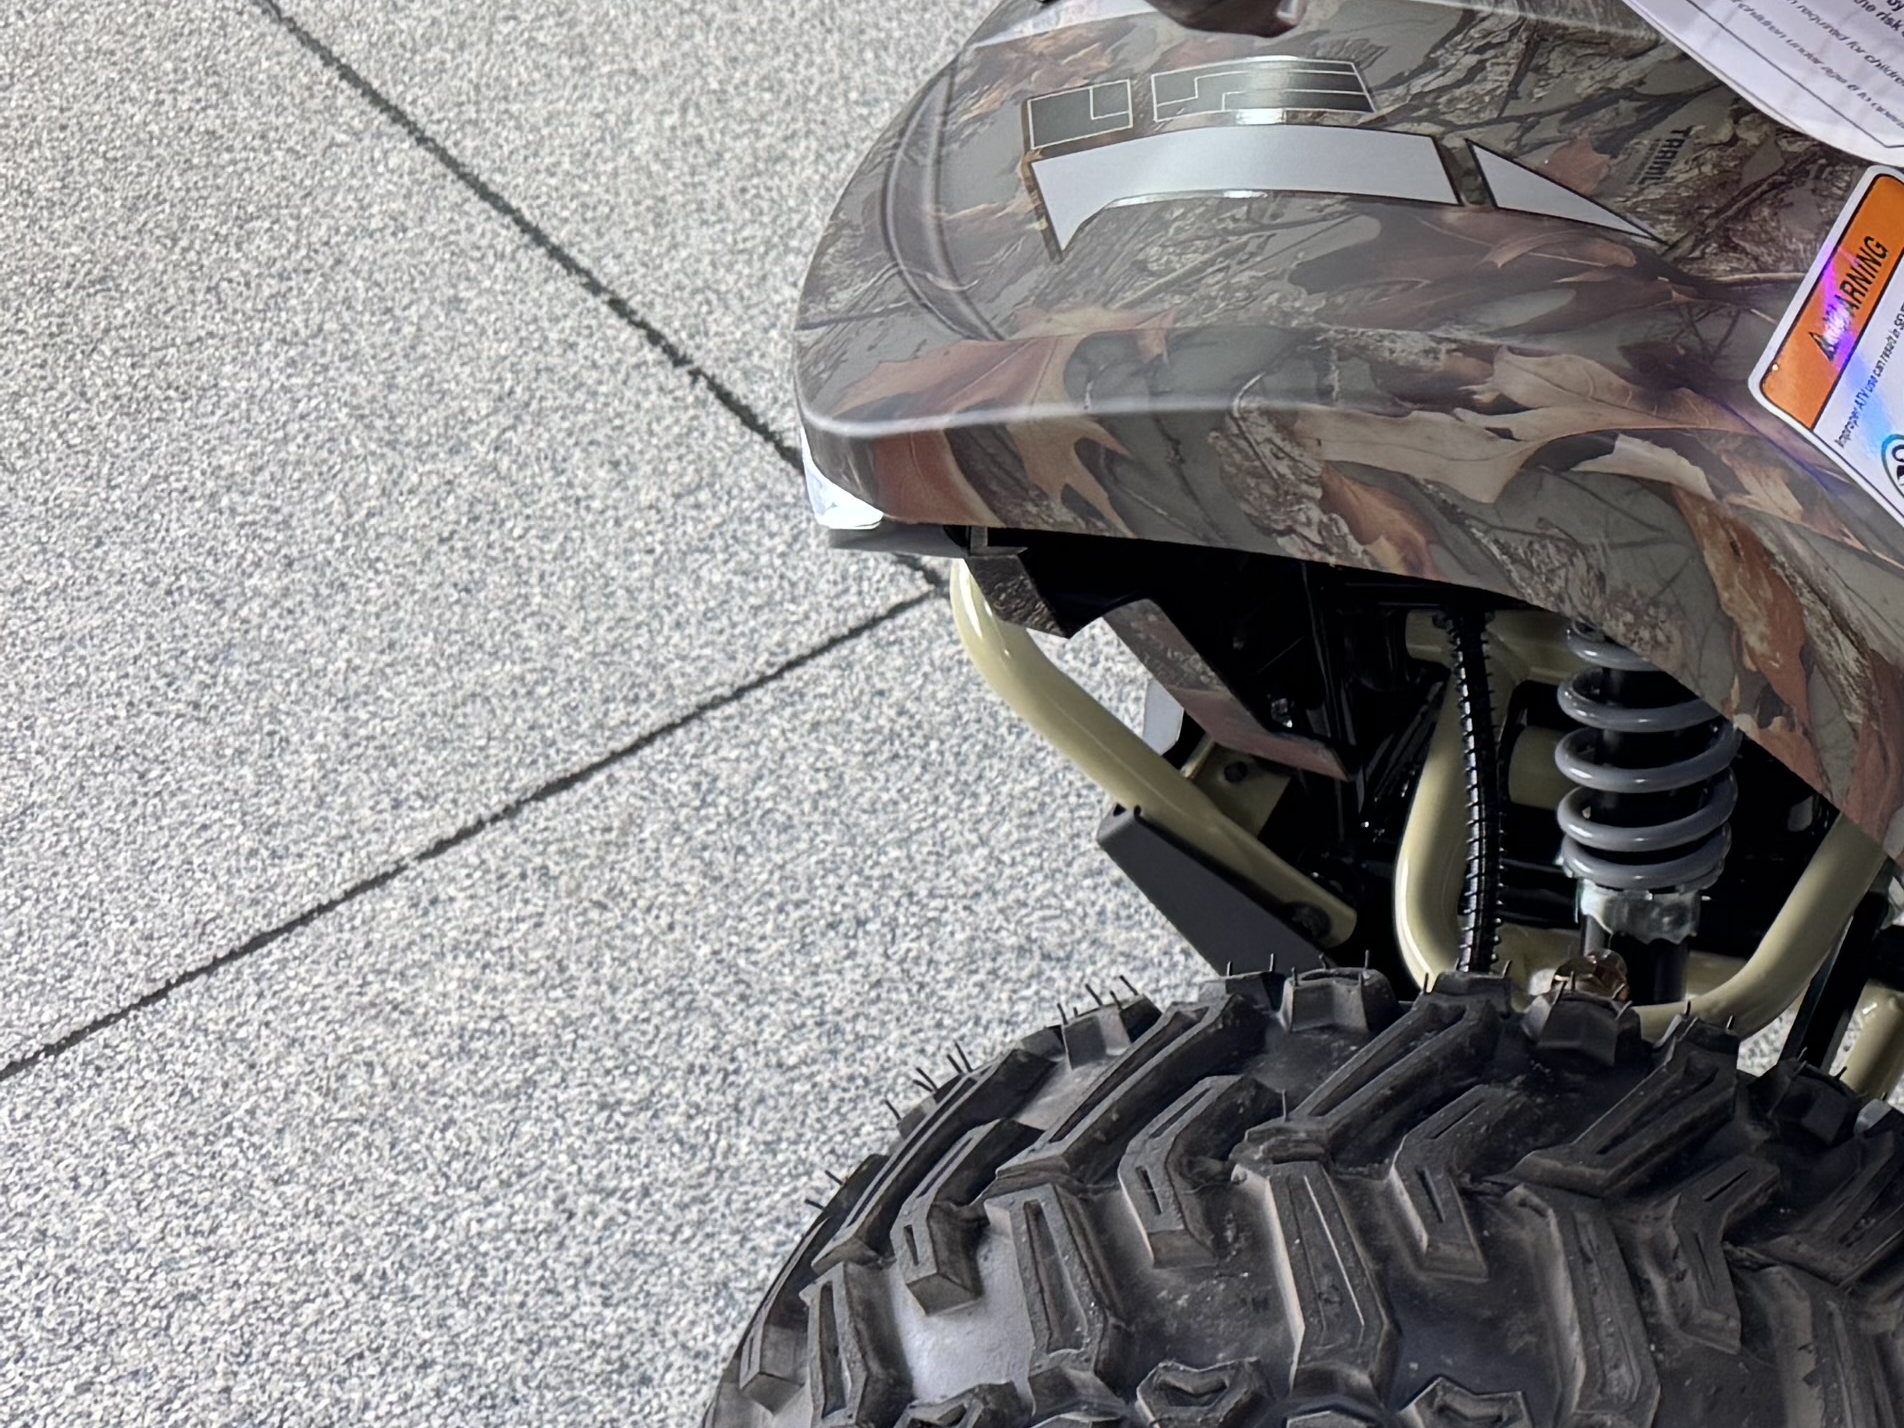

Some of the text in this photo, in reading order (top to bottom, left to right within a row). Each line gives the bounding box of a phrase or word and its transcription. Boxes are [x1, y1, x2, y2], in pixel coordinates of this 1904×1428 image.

[1875, 11, 1903, 31] risk
[1854, 388, 1869, 410] ATV
[1864, 374, 1878, 392] use
[1872, 359, 1885, 377] can
[1879, 335, 1897, 362] result
